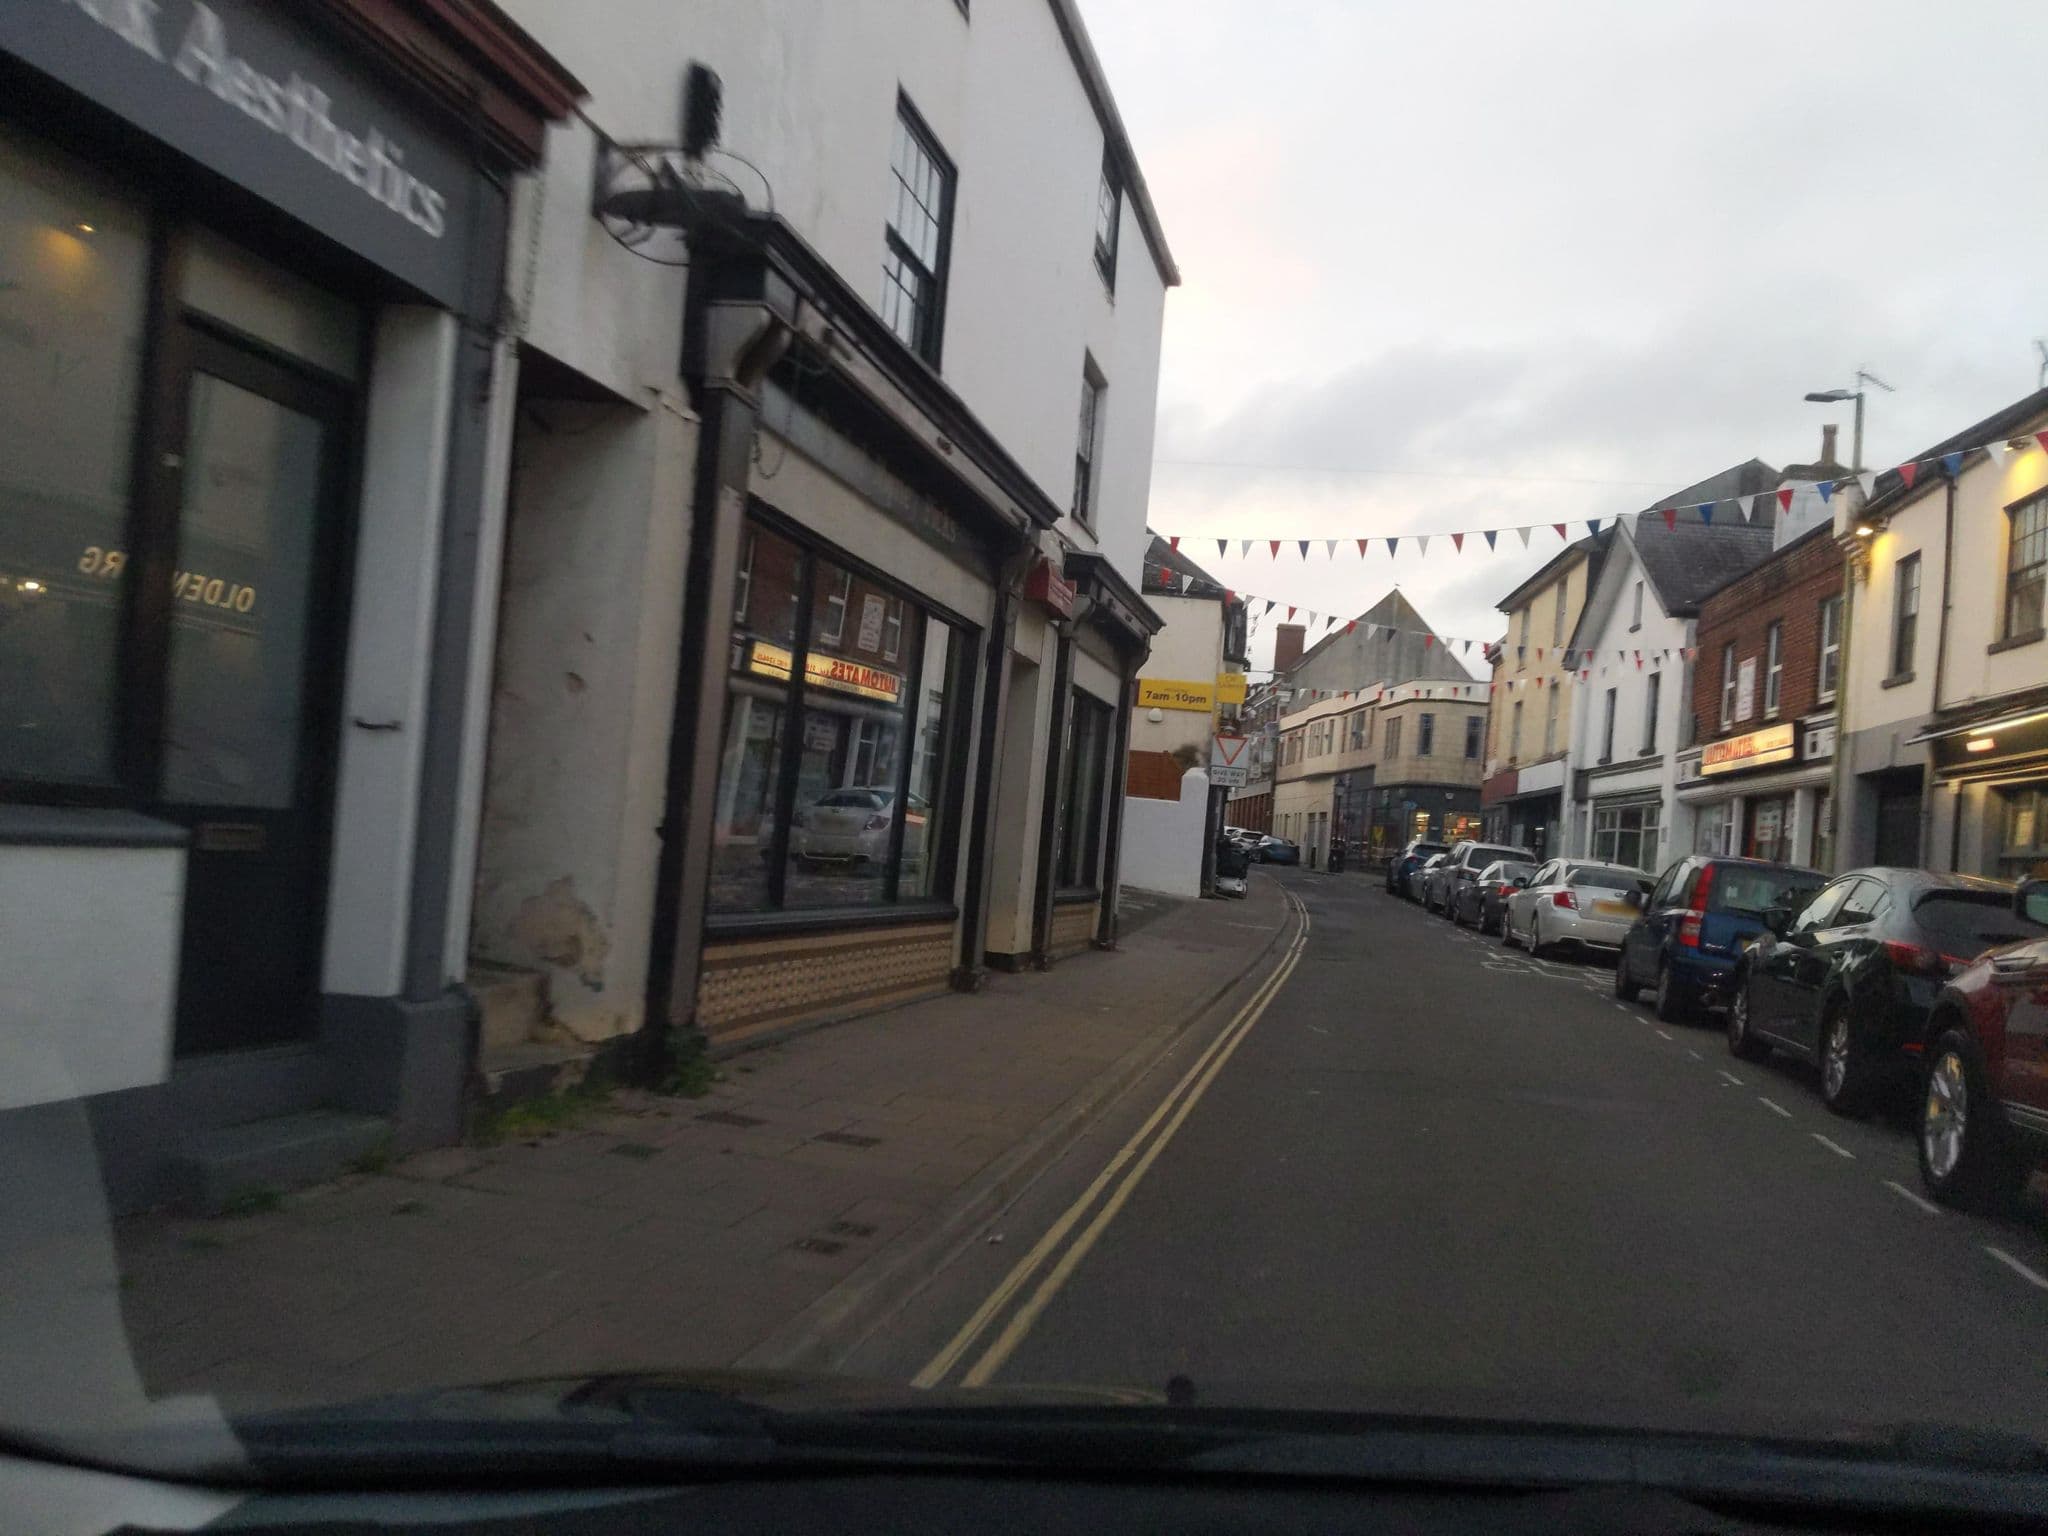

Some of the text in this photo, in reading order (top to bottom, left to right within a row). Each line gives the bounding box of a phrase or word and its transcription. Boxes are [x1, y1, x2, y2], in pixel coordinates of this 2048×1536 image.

[174, 2, 446, 239] Aesthetics
[1145, 690, 1207, 704] 7am 10pm
